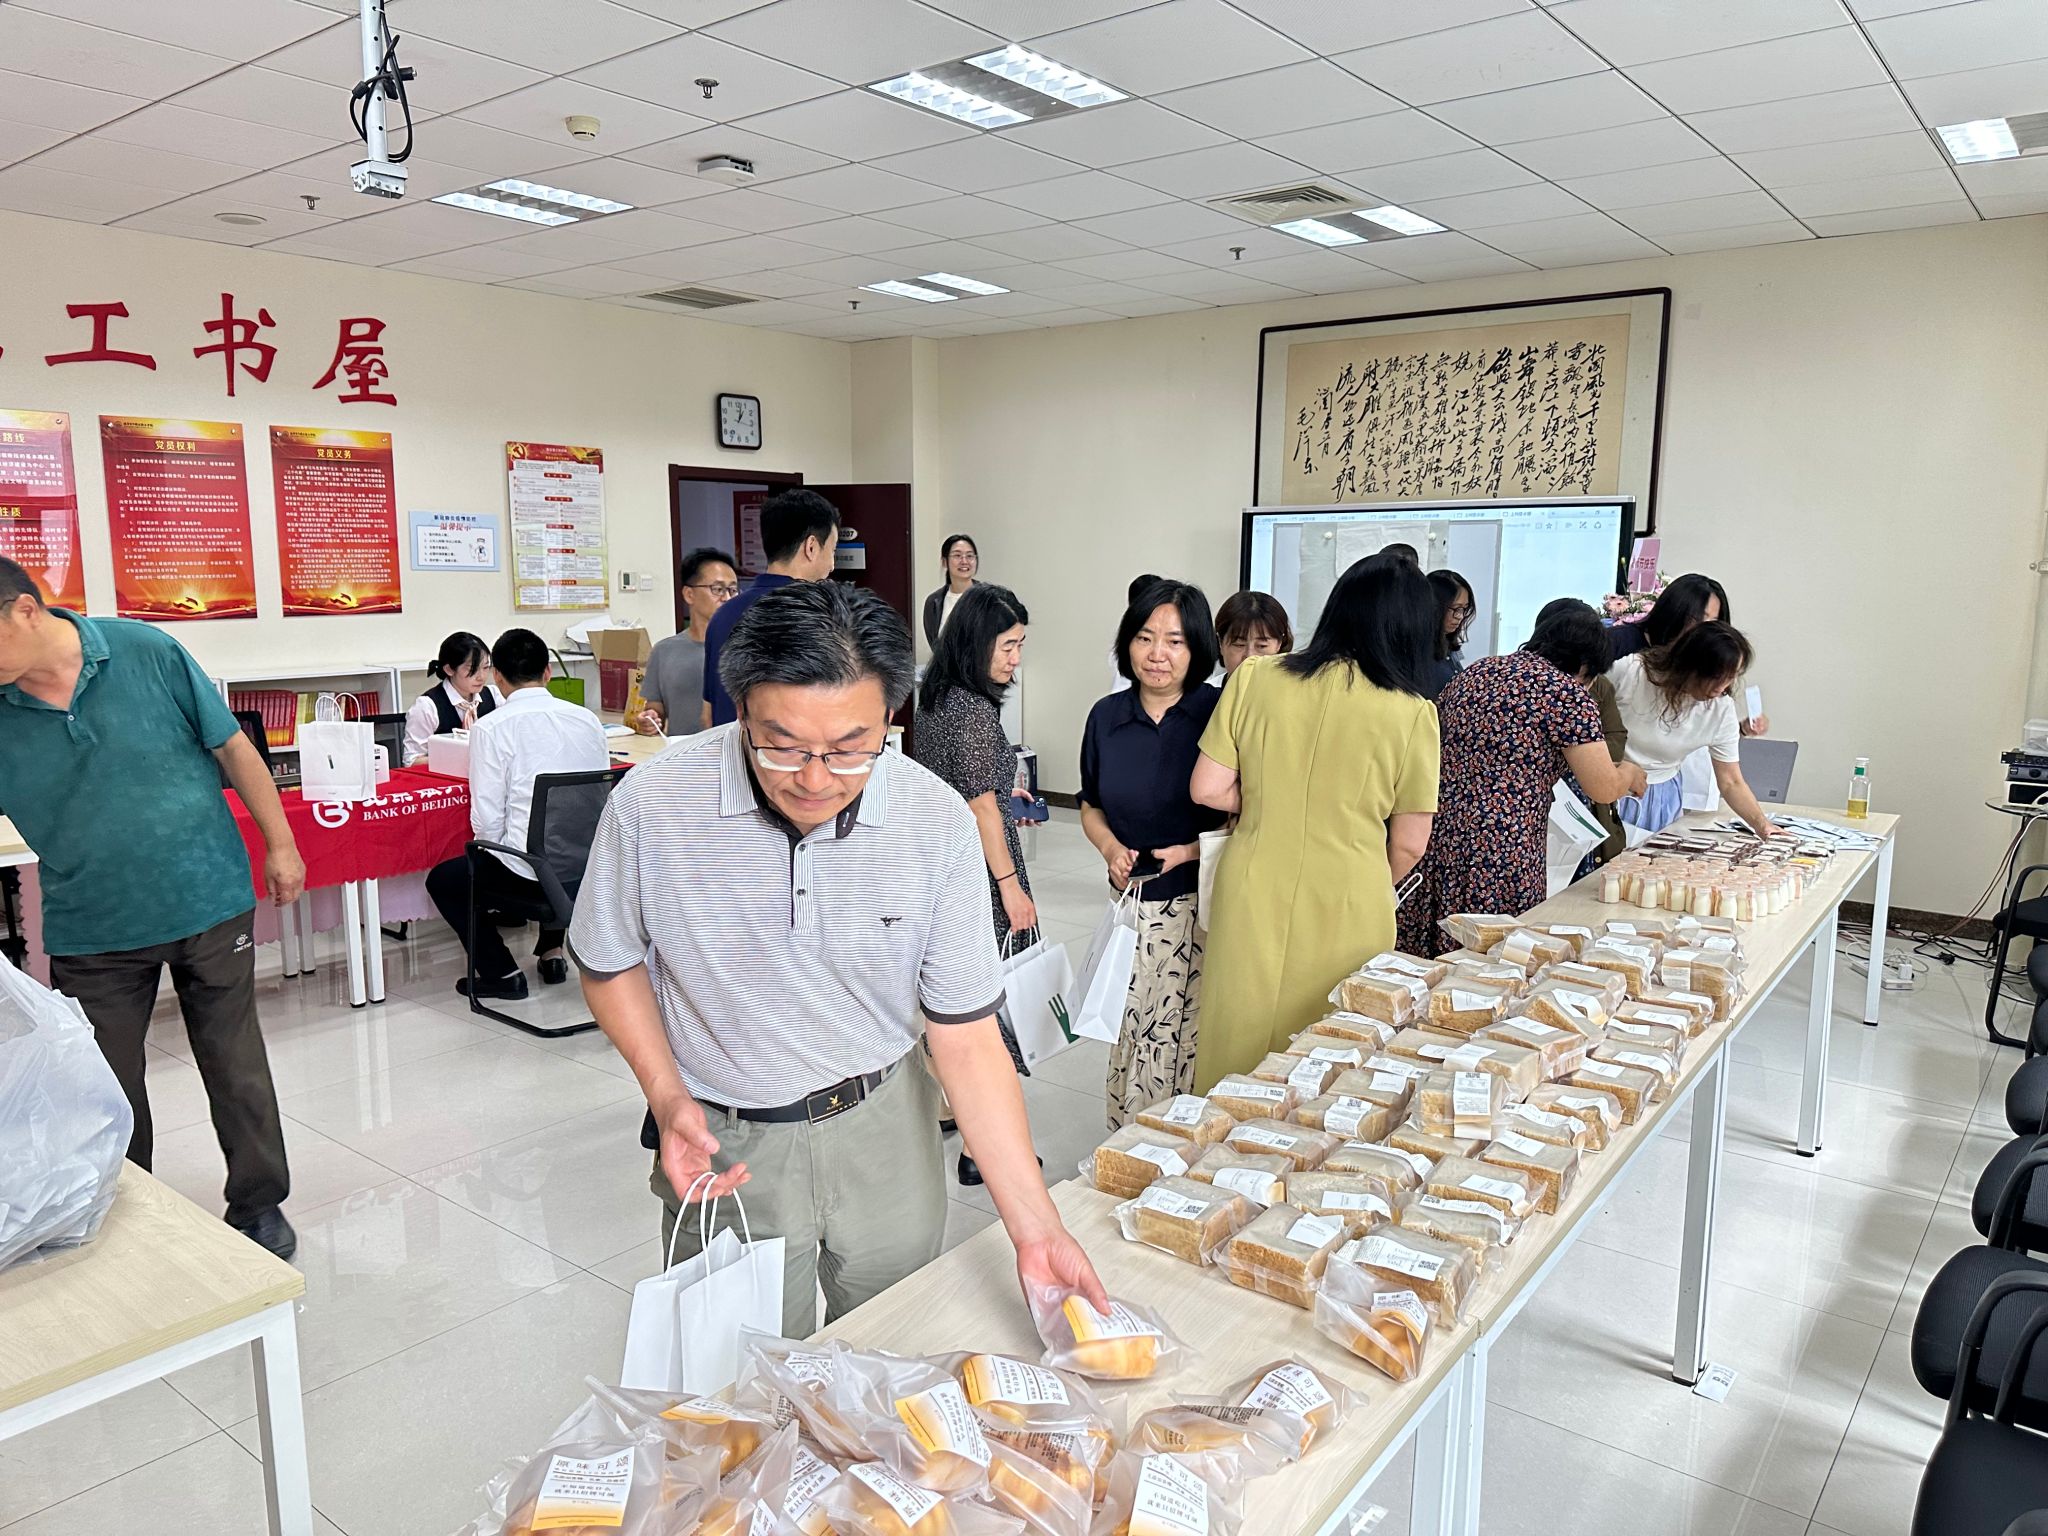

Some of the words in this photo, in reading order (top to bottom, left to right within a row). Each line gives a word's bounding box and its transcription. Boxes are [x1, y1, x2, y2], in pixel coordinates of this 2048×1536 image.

[0, 293, 398, 406] 工书屋
[0, 432, 26, 443] 路线
[155, 440, 196, 451] 党员权利
[317, 448, 352, 459] 党员义务
[363, 807, 398, 821] BANK
[402, 803, 418, 815] OF
[422, 794, 468, 812] BEIJING
